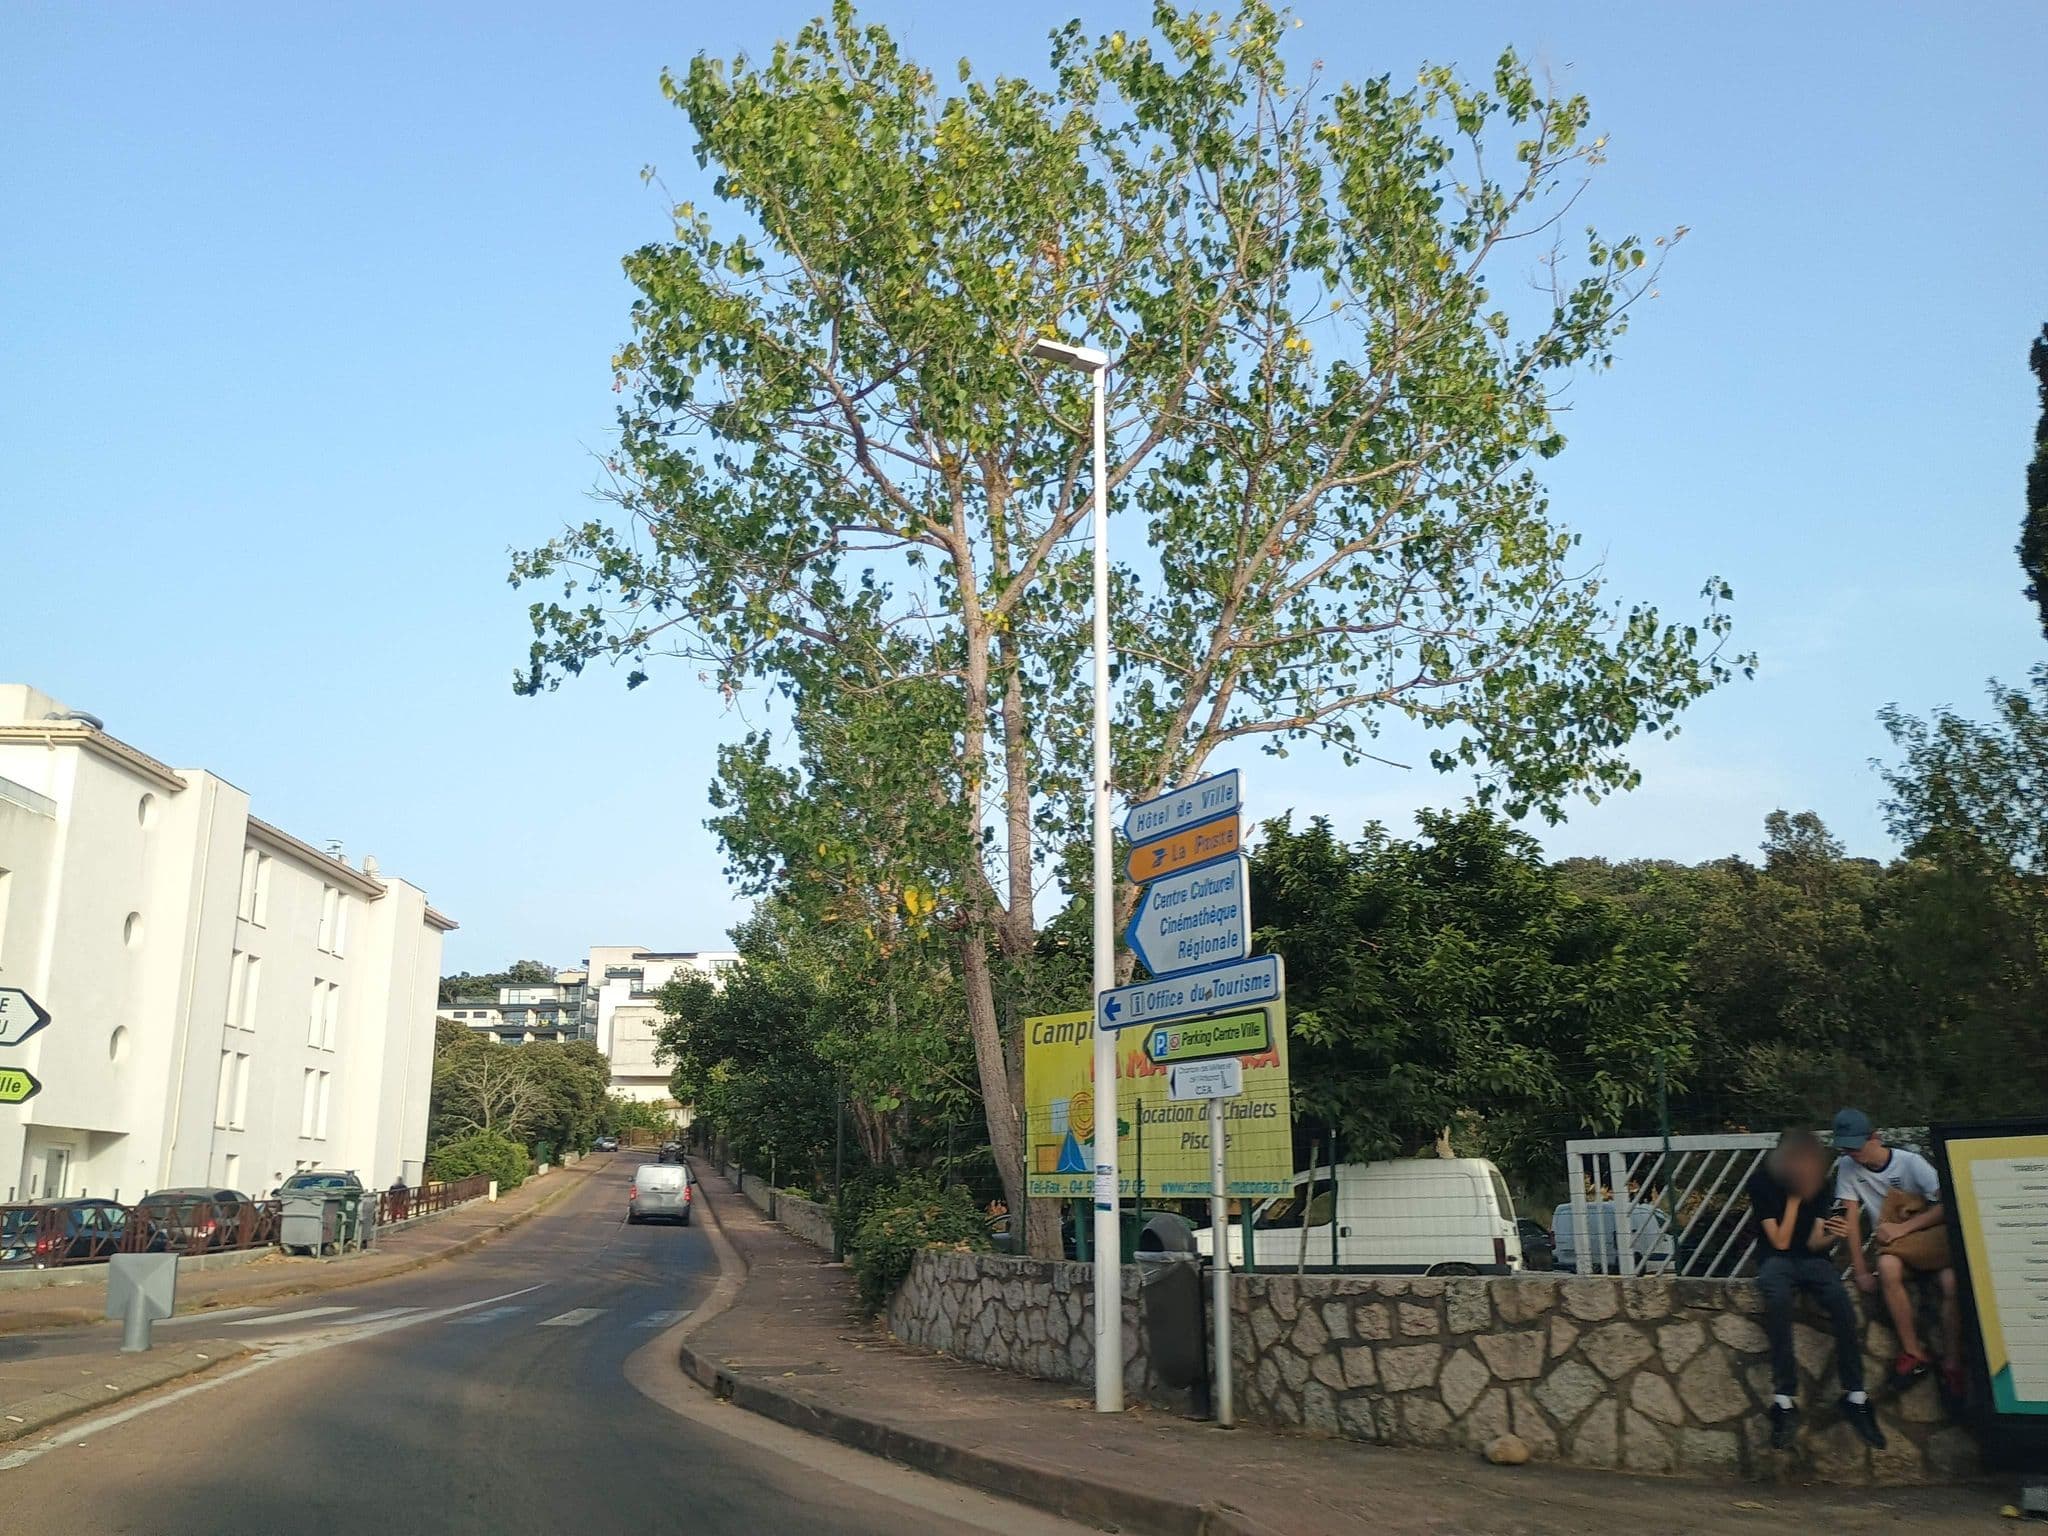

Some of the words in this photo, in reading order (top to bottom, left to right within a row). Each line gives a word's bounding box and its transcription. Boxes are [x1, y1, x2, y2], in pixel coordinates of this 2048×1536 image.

[1136, 805, 1170, 832] Hôtel
[1177, 799, 1192, 817] de
[1202, 785, 1233, 809] Ville
[1172, 844, 1186, 861] La
[1195, 829, 1233, 854] Poste
[1153, 889, 1188, 911] Centre
[1190, 870, 1236, 900] Culturel
[1160, 905, 1237, 936] Cinémathèque
[1178, 929, 1238, 960] Régionale
[1147, 989, 1184, 1010] Office
[1190, 983, 1205, 1002] du
[1212, 973, 1271, 998] Tourisme
[1181, 1030, 1211, 1047] Parking
[1213, 1027, 1240, 1041] Centre
[1240, 1022, 1260, 1038] Ville
[1137, 1104, 1193, 1123] ocation
[1181, 1131, 1232, 1149] Pisce
